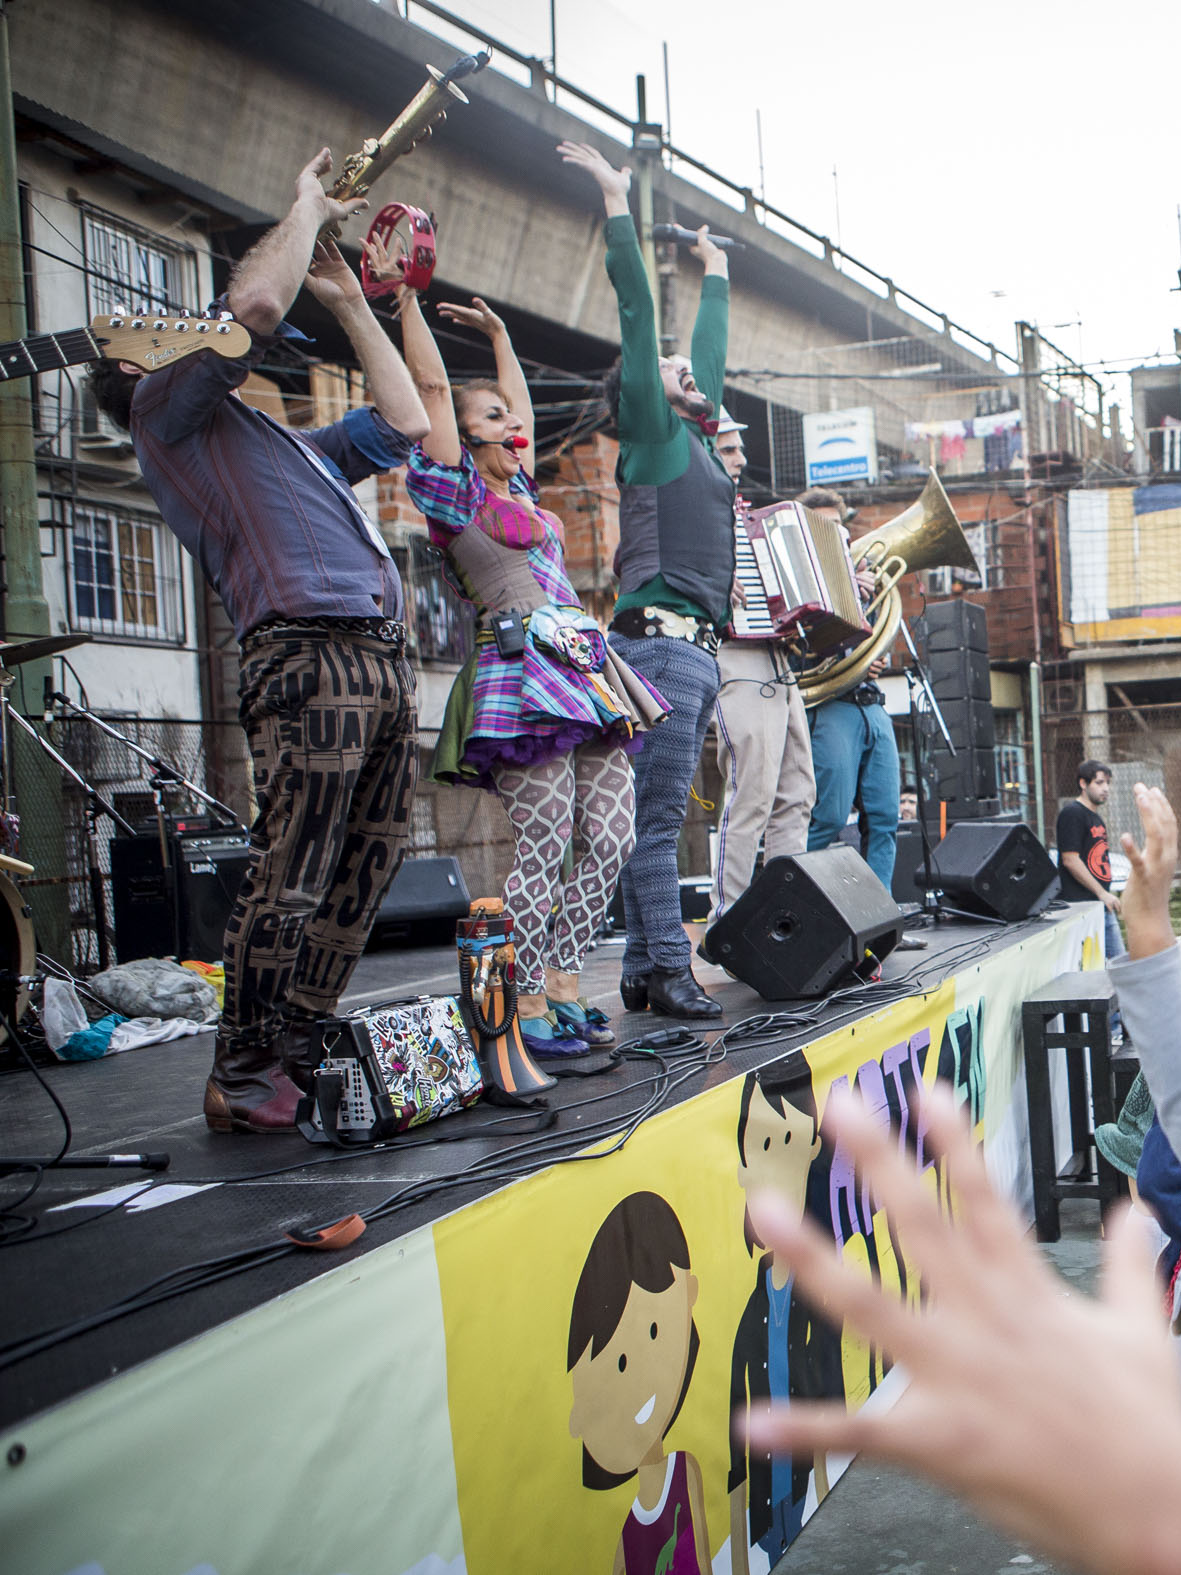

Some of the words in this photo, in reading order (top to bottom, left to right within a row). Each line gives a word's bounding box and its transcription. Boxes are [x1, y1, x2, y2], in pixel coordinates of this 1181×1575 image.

[145, 347, 177, 368] Fender
[811, 462, 867, 478] Telecentro
[190, 862, 217, 875] Laney
